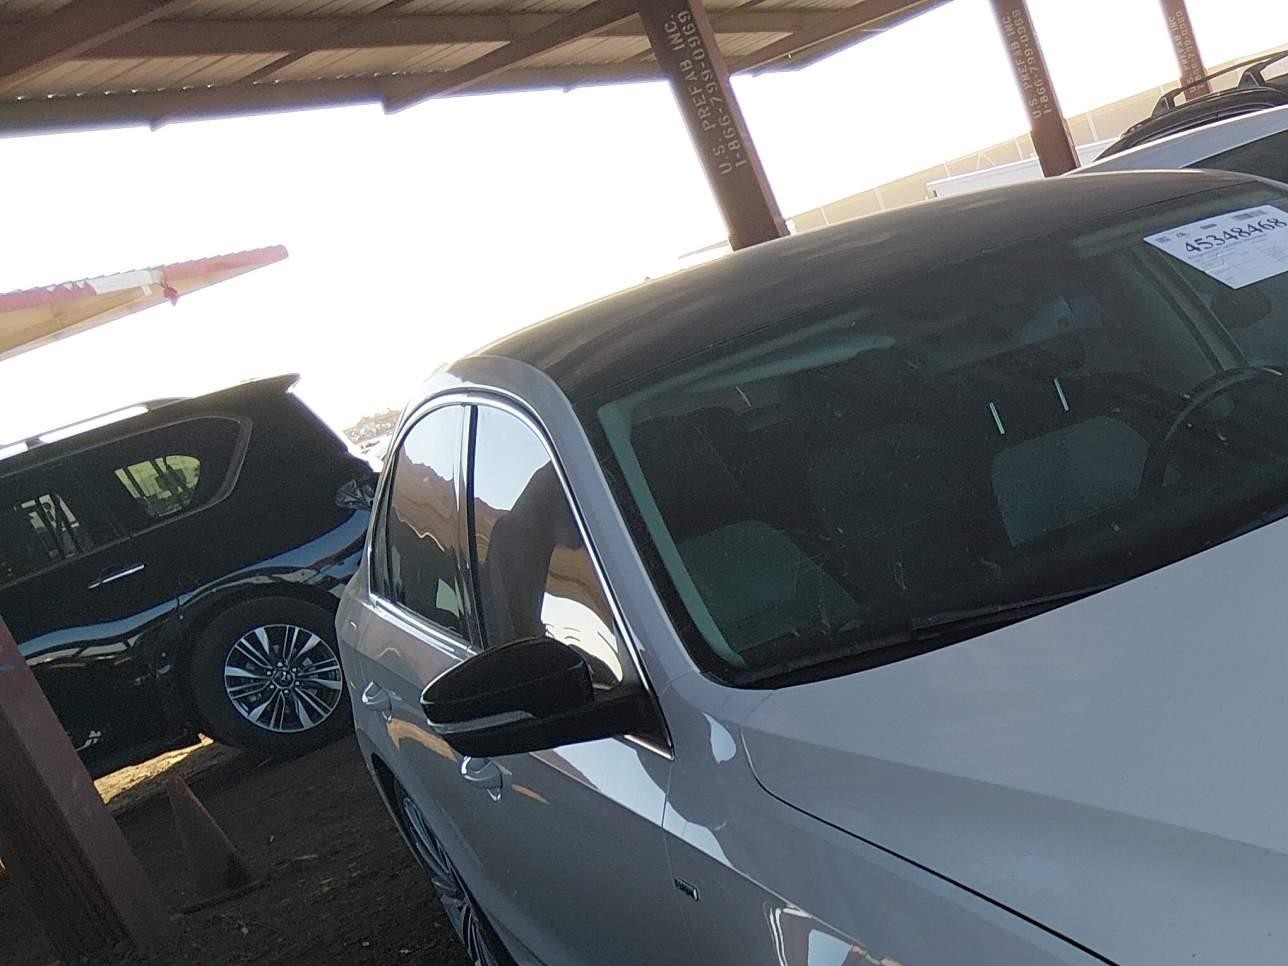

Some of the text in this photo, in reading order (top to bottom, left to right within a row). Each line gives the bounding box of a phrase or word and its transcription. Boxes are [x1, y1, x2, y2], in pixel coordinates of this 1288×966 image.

[663, 14, 685, 52] INC.
[678, 60, 717, 132] PREFAB
[1185, 217, 1288, 253] 45348468
